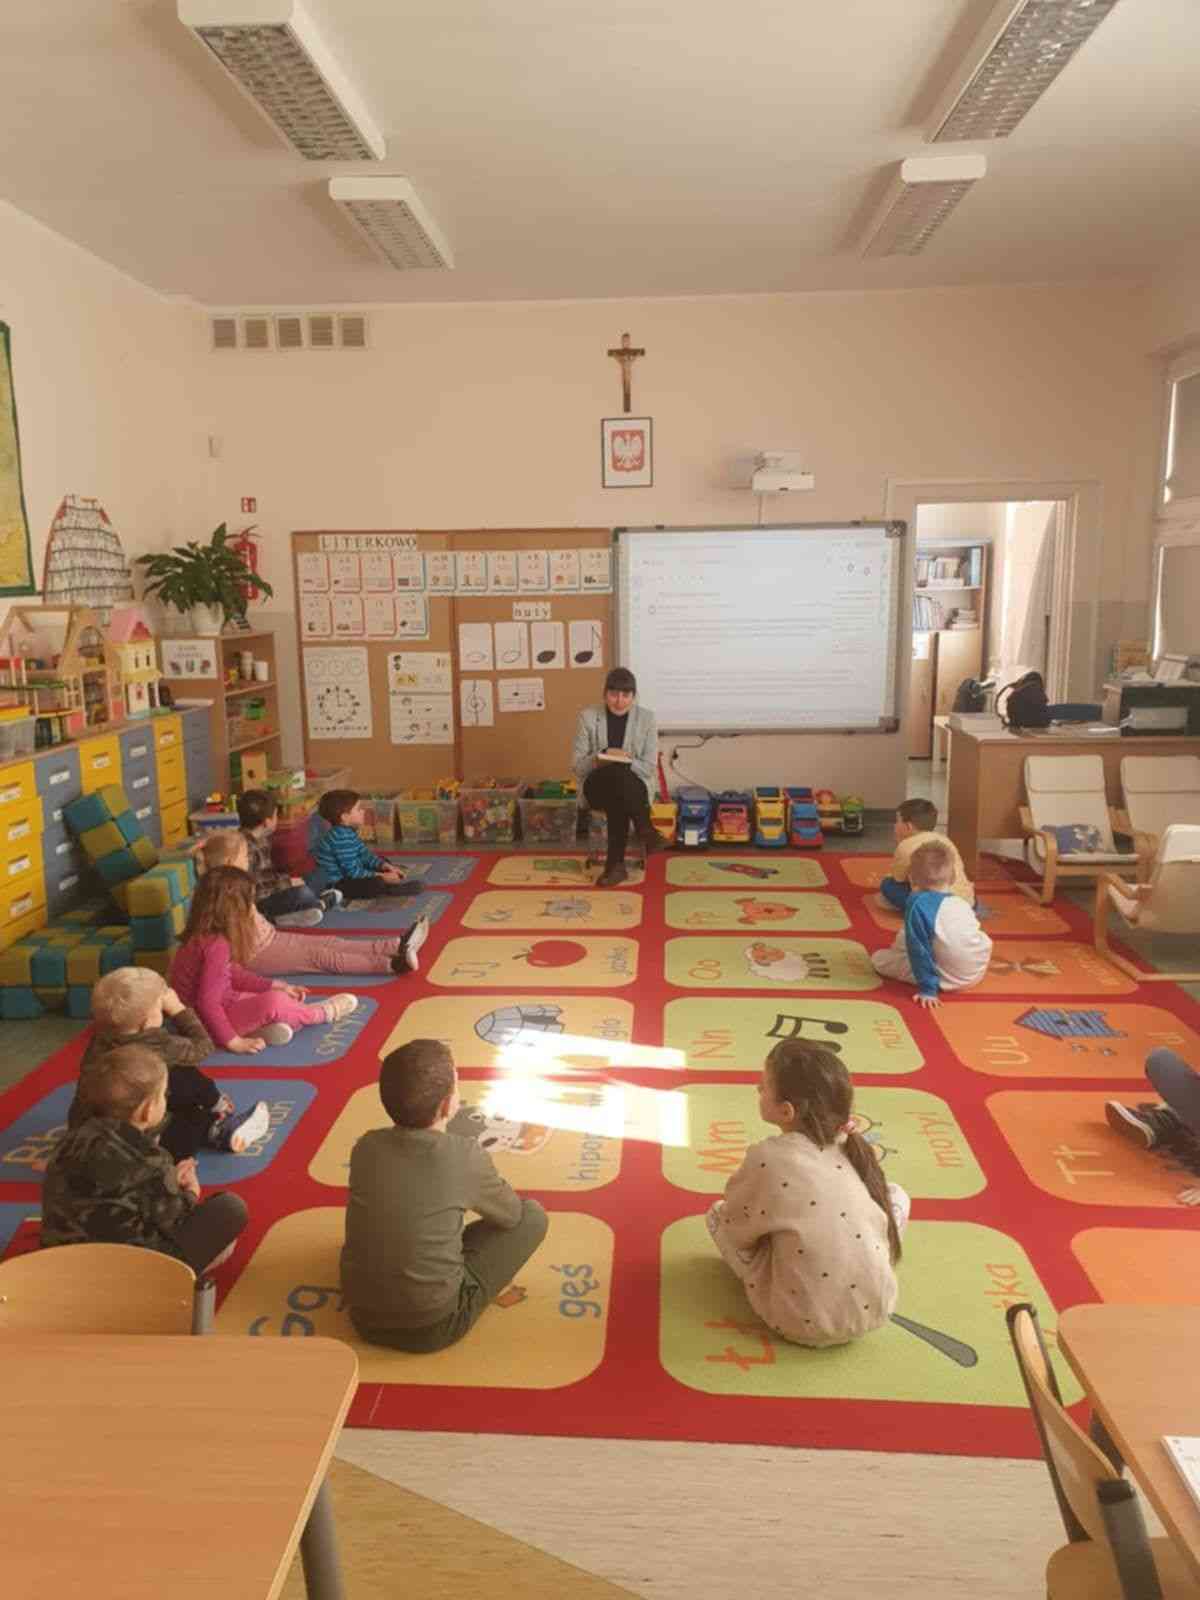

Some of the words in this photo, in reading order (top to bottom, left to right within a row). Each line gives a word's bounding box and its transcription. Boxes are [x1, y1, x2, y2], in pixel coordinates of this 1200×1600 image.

[321, 535, 417, 550] LITERKOWO
[688, 959, 722, 980] Oo
[692, 1028, 736, 1059] Nn
[981, 1035, 1031, 1065] Uu
[697, 1121, 746, 1174] Mm
[1053, 1144, 1116, 1185] Tt
[552, 1263, 602, 1319] gęś
